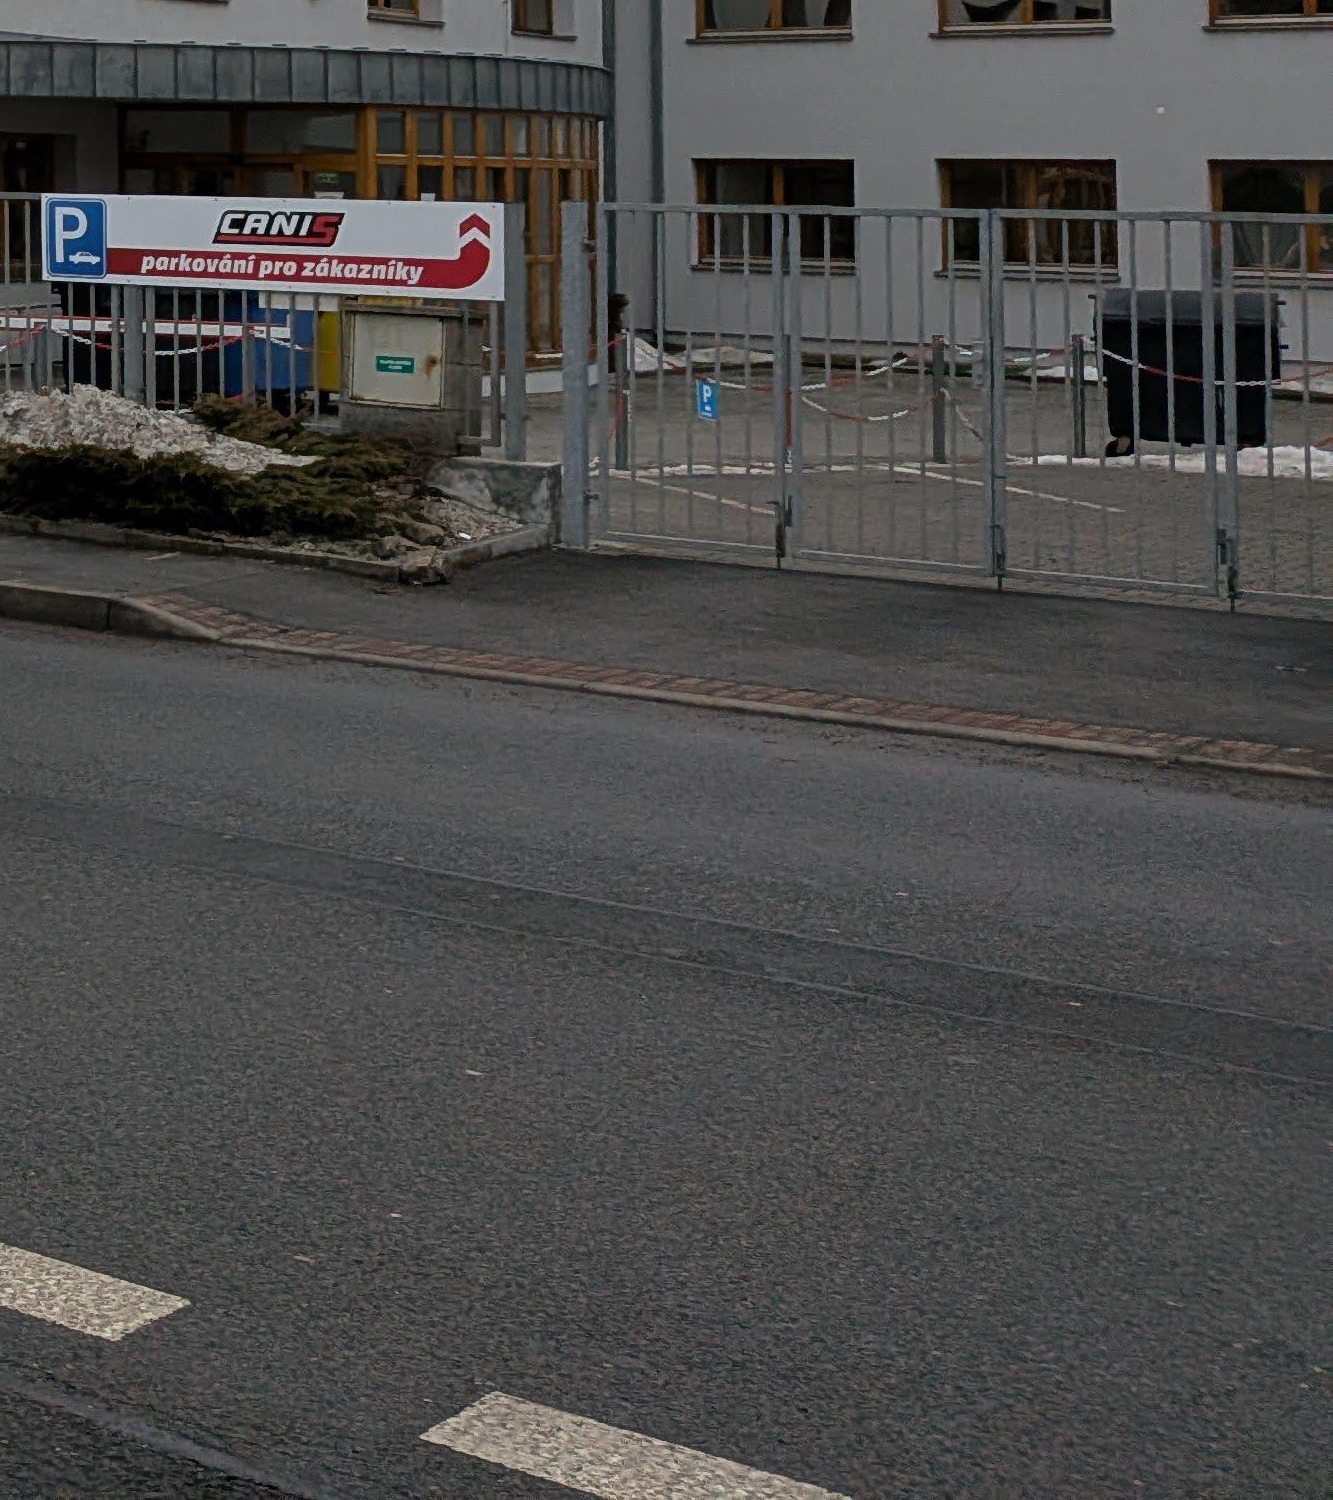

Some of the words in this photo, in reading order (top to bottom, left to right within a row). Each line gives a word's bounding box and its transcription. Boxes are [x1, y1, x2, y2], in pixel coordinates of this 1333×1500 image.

[55, 206, 88, 263] P
[215, 210, 343, 247] CANIS
[141, 254, 255, 275] parkování
[257, 259, 296, 278] pro
[301, 258, 424, 285] zákazníky
